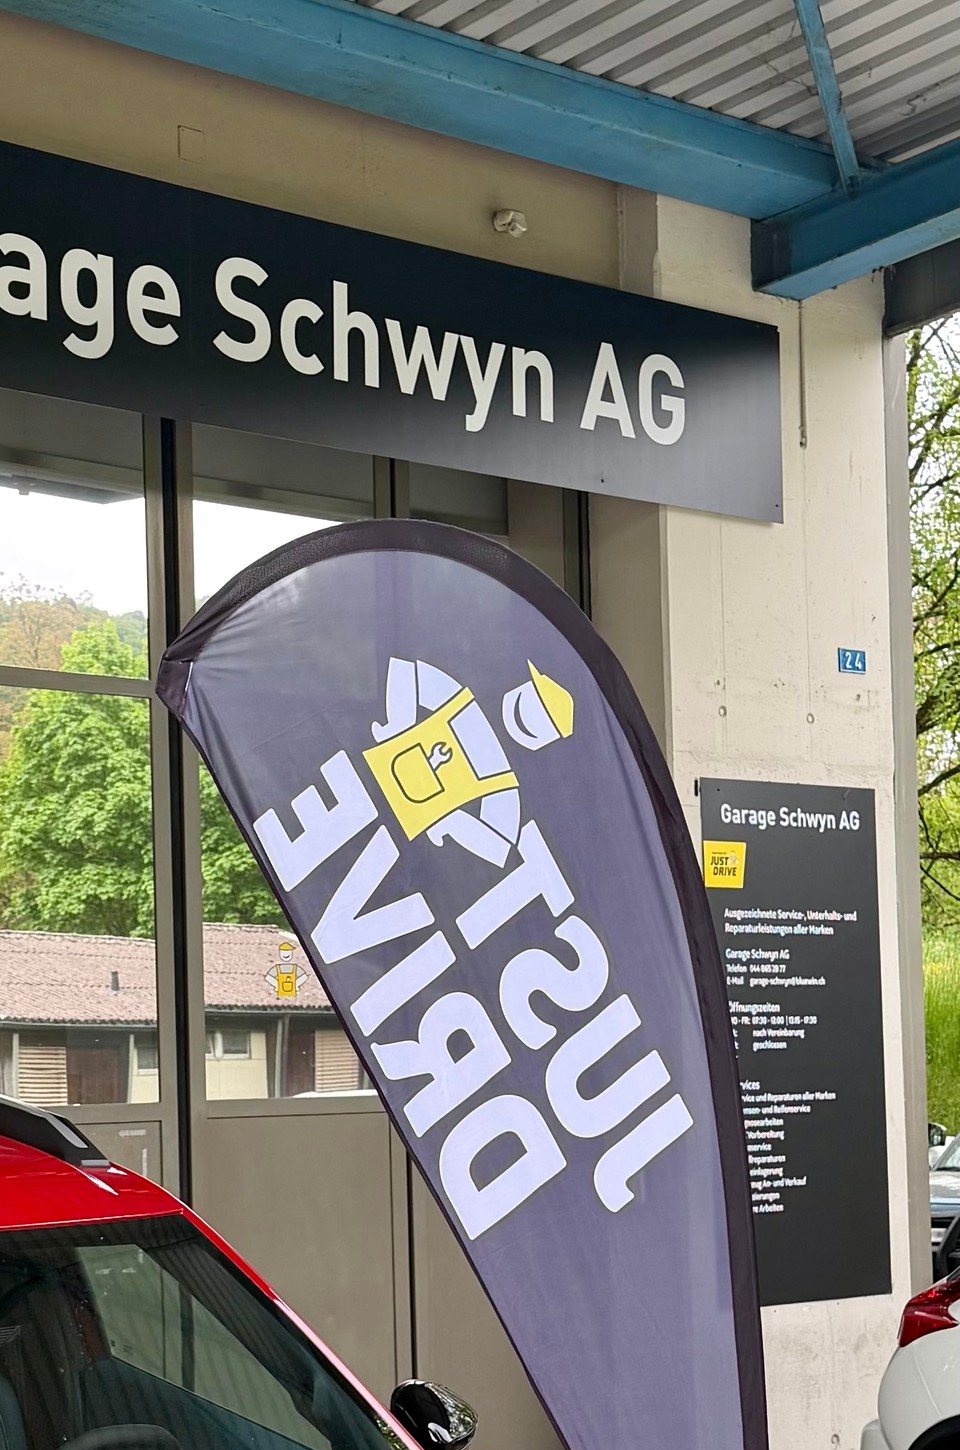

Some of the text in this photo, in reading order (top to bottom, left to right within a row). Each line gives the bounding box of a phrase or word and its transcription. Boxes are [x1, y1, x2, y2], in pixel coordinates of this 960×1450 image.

[212, 256, 554, 433] Schwyn
[579, 341, 686, 446] AG
[845, 651, 862, 670] 24
[720, 803, 860, 833] Garage Schwyn AG
[710, 856, 730, 866] JUST
[712, 866, 738, 877] DRIVE
[724, 908, 777, 921] Ausgezeichnete
[843, 911, 857, 921] und
[724, 923, 834, 936] Reparaturleistungen aller Marken
[725, 948, 790, 962] Garage Schwyn AG
[726, 964, 747, 973] Telefon
[726, 976, 744, 985] E-Mail
[753, 1028, 805, 1039] nach Vereinbarung
[753, 1040, 787, 1052] geschlossen
[755, 1093, 767, 1102] und
[767, 1092, 802, 1103] Reparaturen
[802, 1091, 815, 1100] aller
[815, 1091, 836, 1100] Marken
[761, 1105, 773, 1114] und
[773, 1104, 811, 1114] Reifenservice
[773, 1178, 784, 1187] und
[785, 1176, 807, 1187] Verkauf
[759, 1204, 784, 1213] Arbeiten
